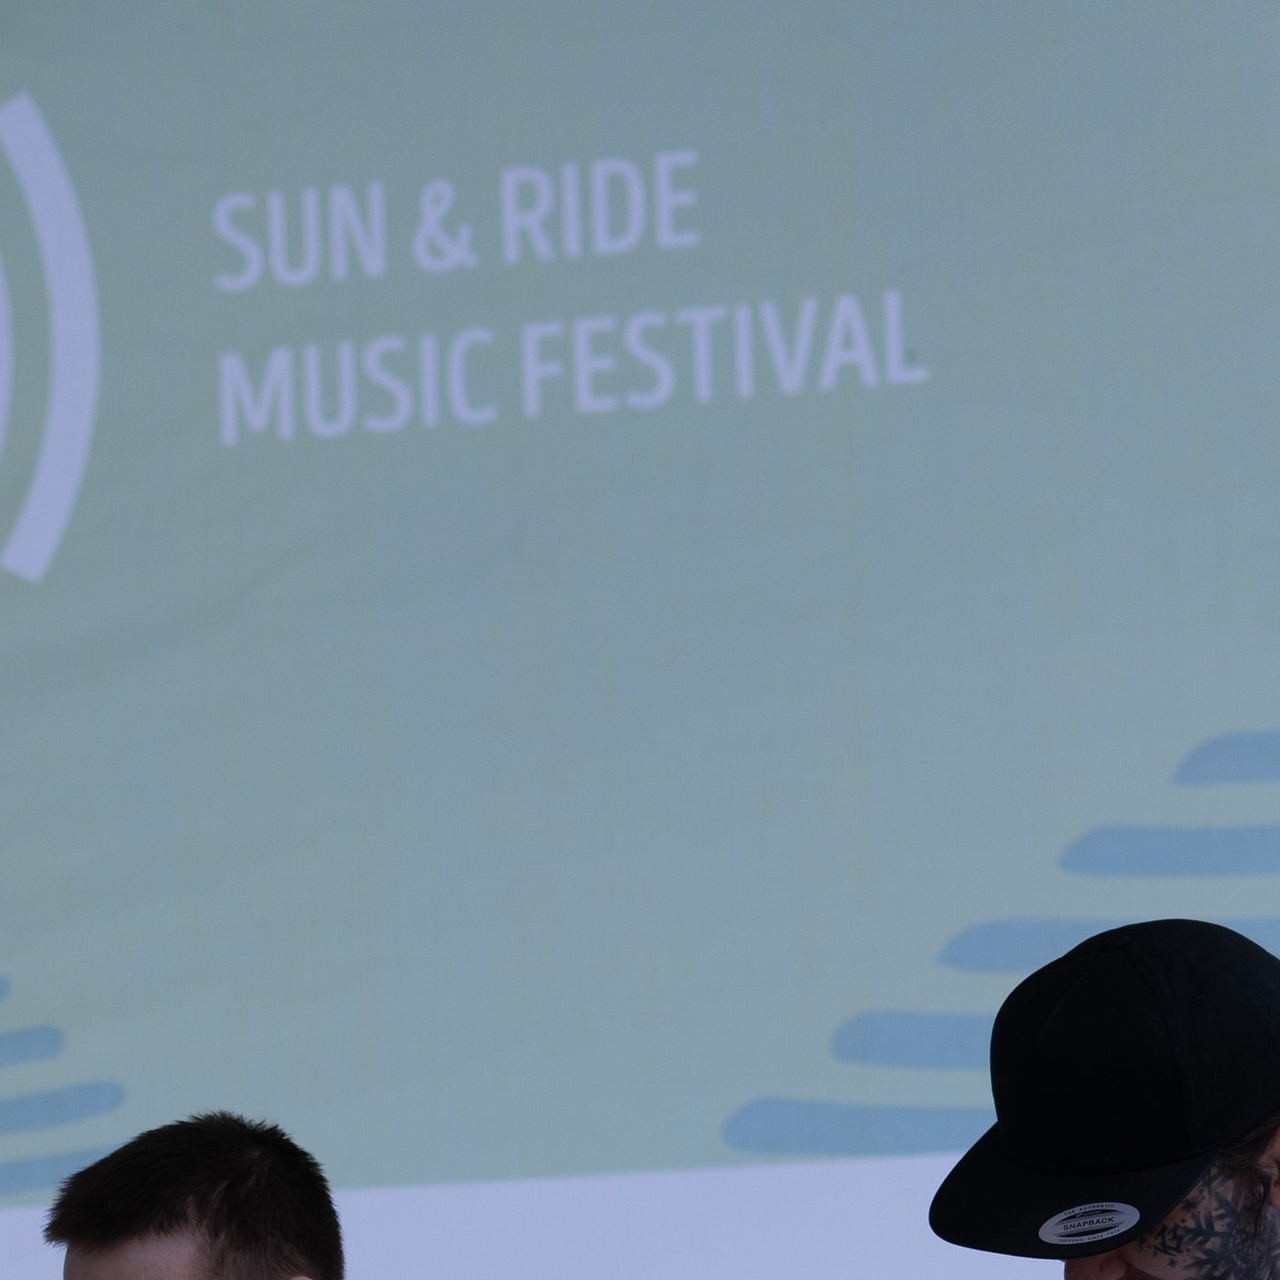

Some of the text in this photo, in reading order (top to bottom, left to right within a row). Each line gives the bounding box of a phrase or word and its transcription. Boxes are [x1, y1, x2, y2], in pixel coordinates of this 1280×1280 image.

[213, 149, 702, 292] SUN & RIDE
[217, 288, 930, 447] MUSIC FESTIVAL
[1062, 1216, 1115, 1232] SNAPBACK
